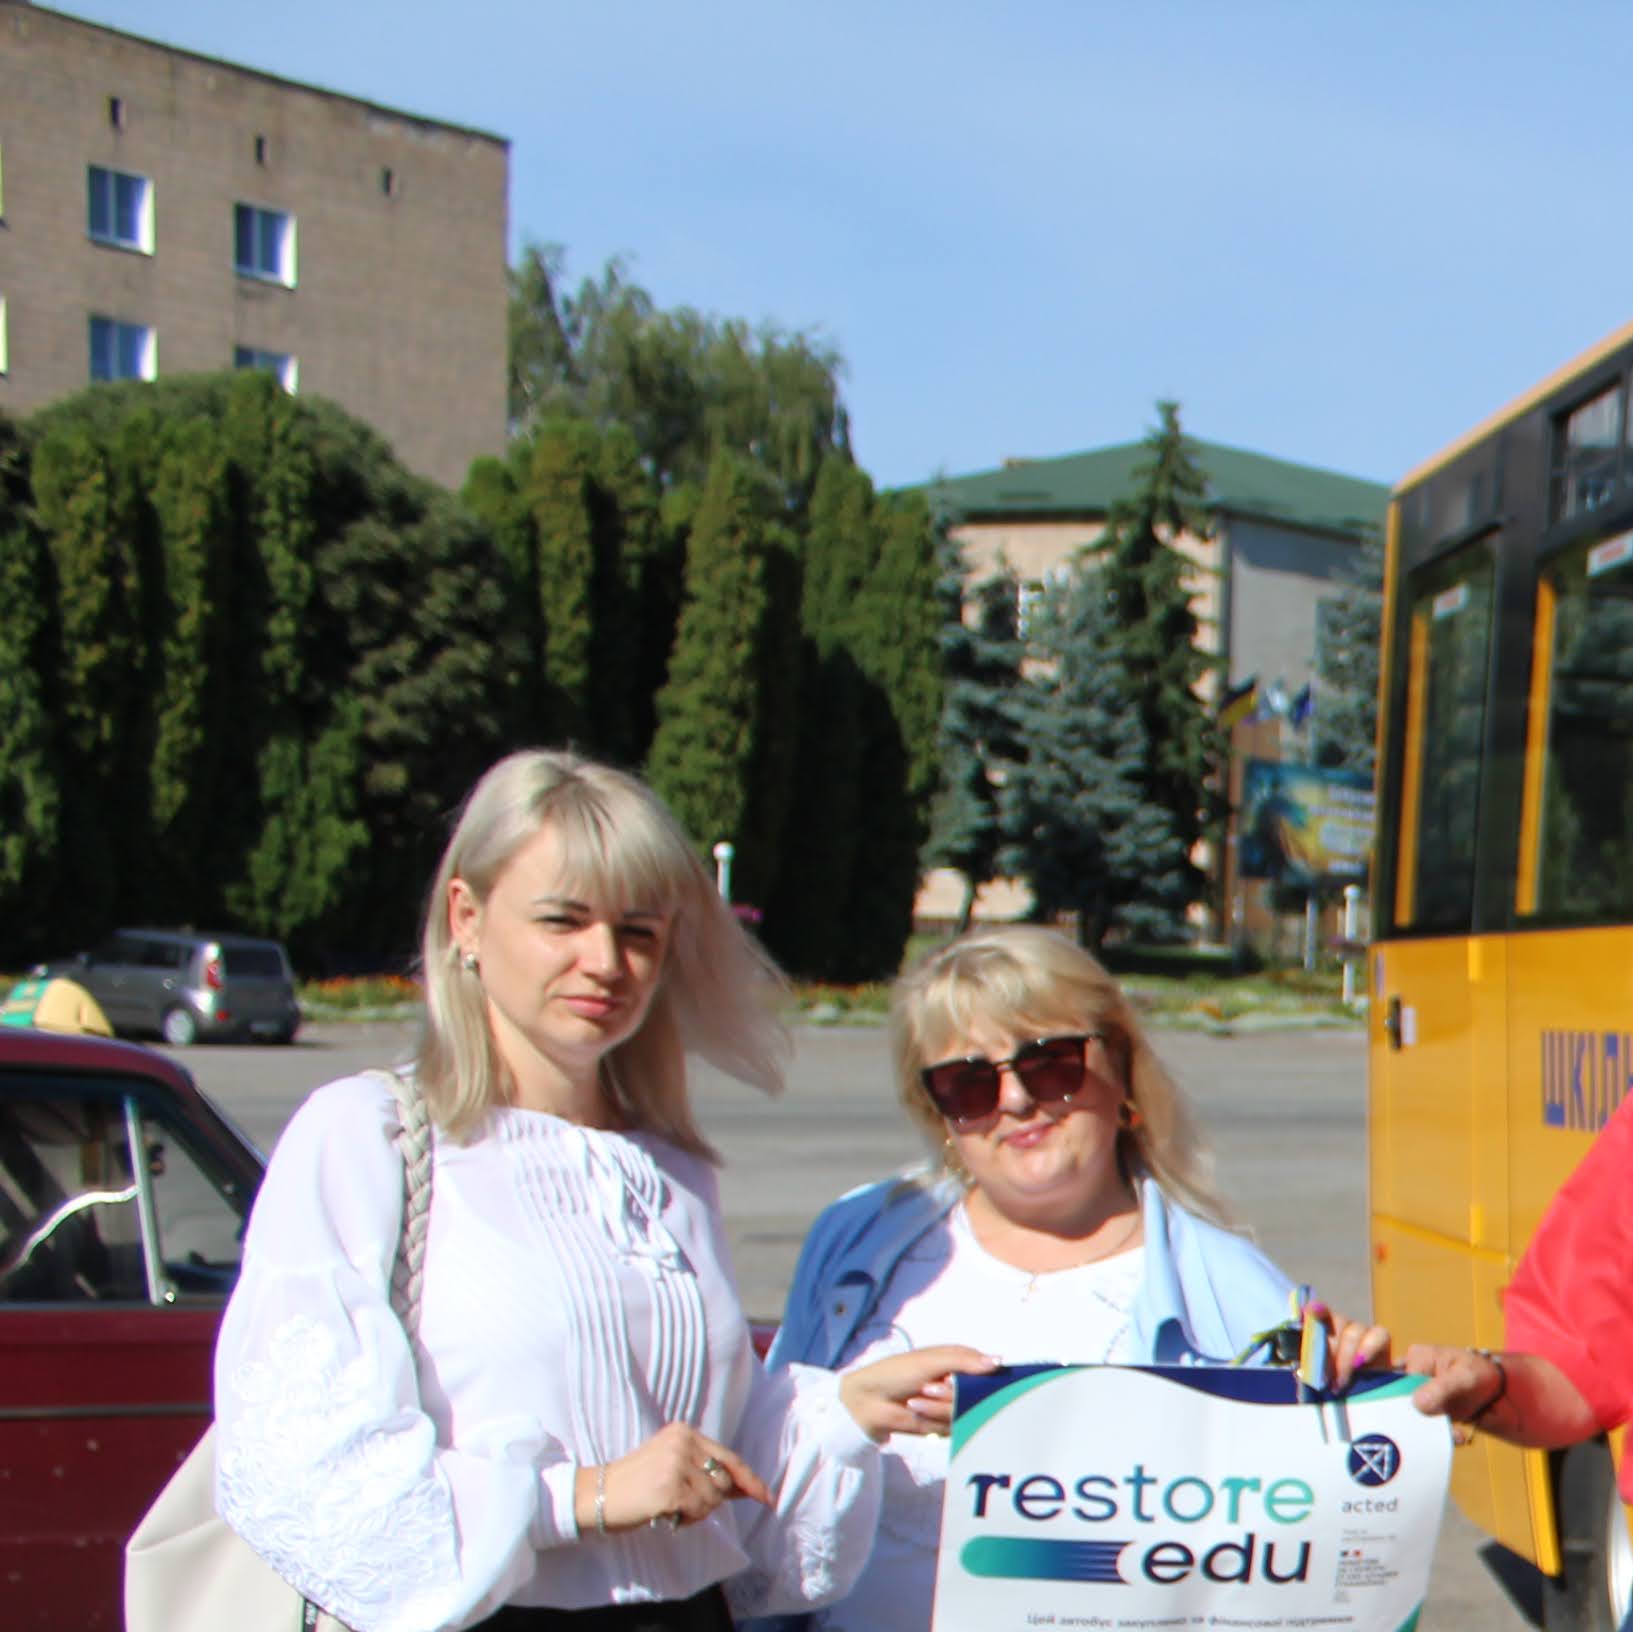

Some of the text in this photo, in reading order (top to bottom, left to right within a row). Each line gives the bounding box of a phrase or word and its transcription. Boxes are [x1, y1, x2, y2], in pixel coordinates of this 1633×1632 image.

[966, 1464, 1314, 1525] restore
[1341, 1496, 1399, 1513] acted
[1141, 1533, 1312, 1586] edu
